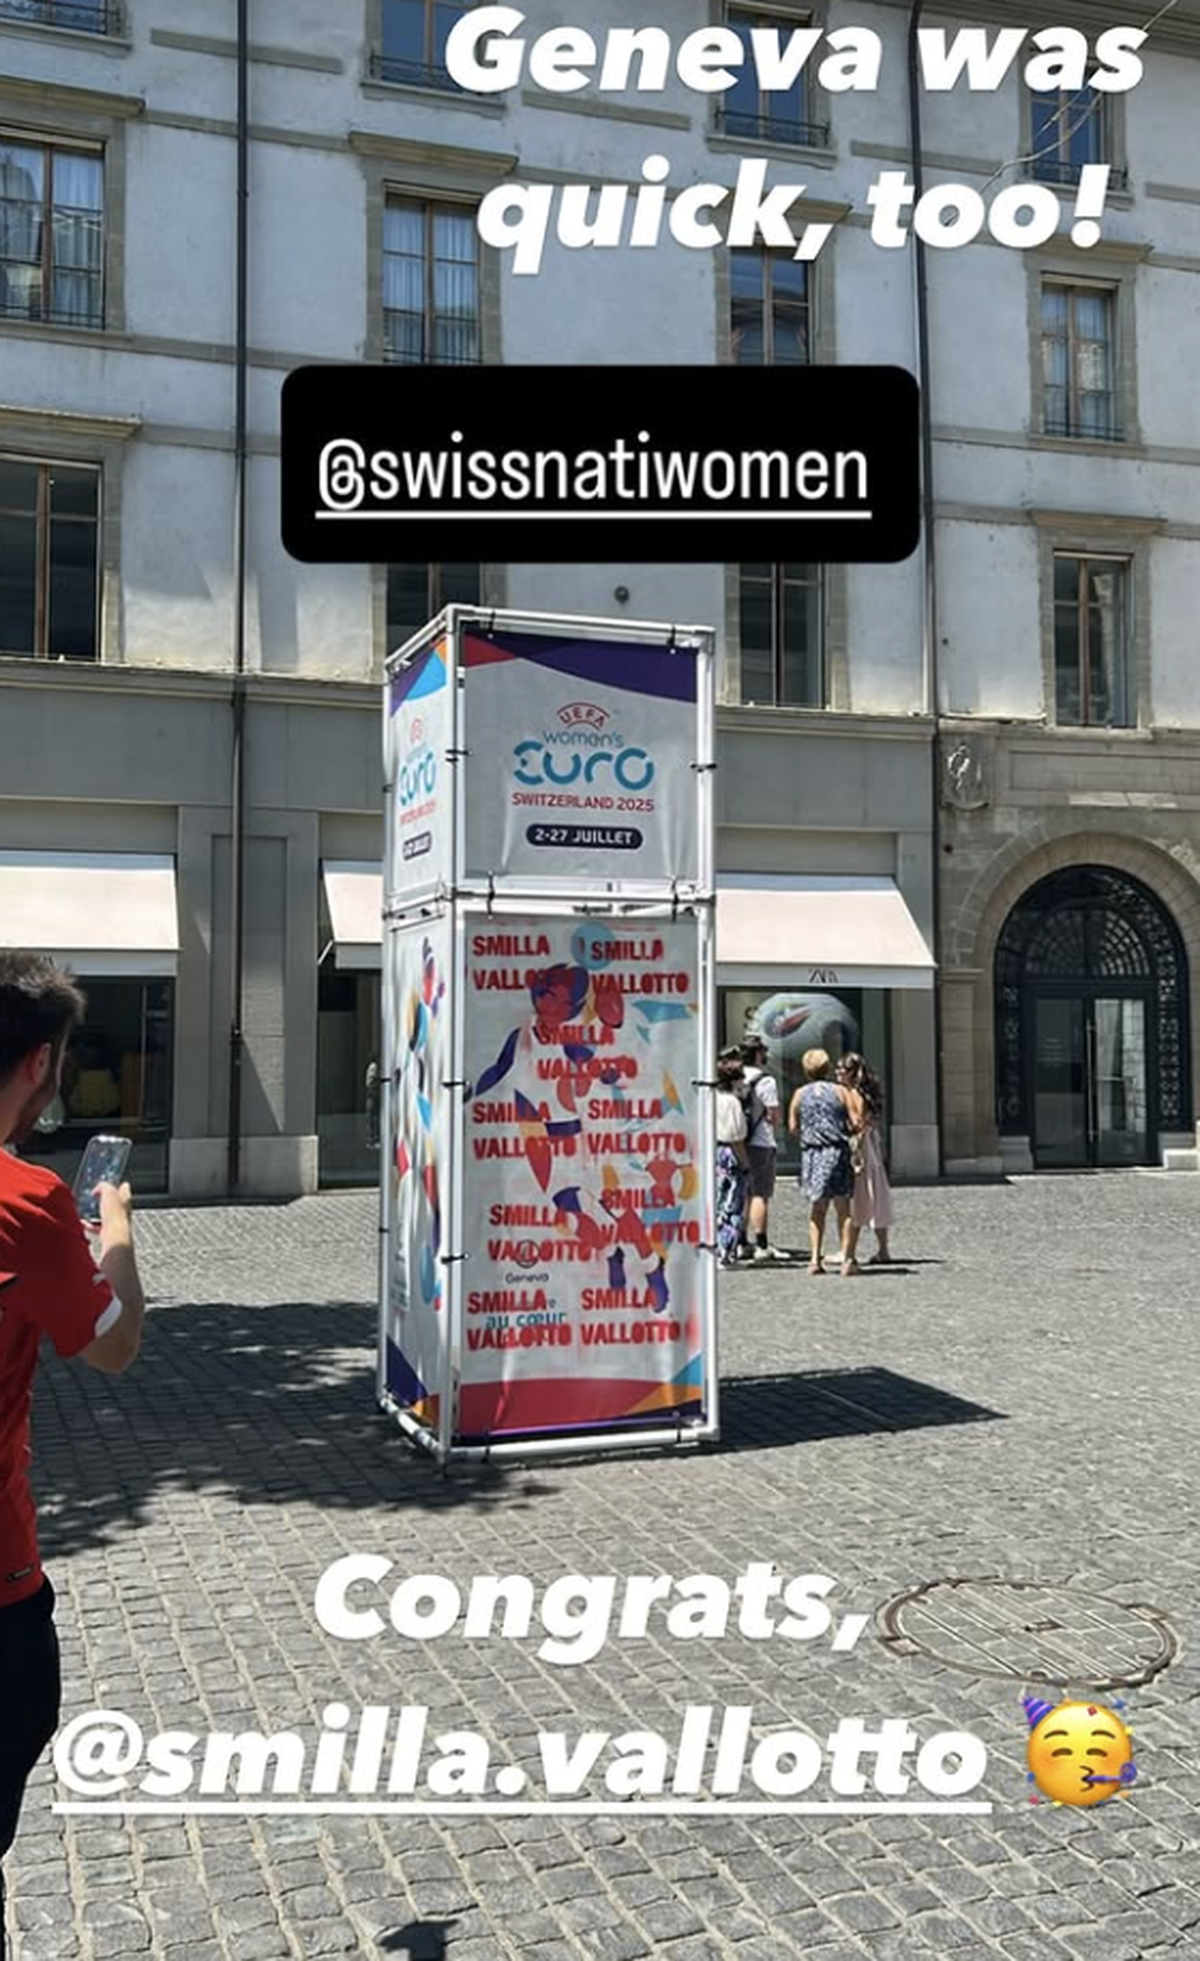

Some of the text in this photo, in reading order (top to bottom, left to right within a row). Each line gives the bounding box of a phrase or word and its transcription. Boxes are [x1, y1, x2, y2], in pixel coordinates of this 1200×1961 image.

[559, 706, 606, 728] UEFA
[543, 731, 624, 748] women's
[512, 792, 655, 812] SWITZERLAND 2025
[572, 829, 633, 845] JUILLET
[472, 936, 550, 956] SMILLA
[591, 938, 664, 961] SMILLA
[472, 968, 575, 990] VALLO
[592, 972, 689, 995] VALLOTTO
[472, 1100, 551, 1124] SMILLA
[588, 1097, 664, 1119] SMILLA
[587, 1132, 686, 1155] VALLOTTO
[489, 1204, 569, 1227] SMILLA
[488, 1238, 591, 1262] VALLOTTO
[467, 1288, 547, 1314] SMILLA
[581, 1287, 657, 1310] SMILLA
[485, 1316, 509, 1330] au
[580, 1321, 681, 1345] VALLOTTO
[466, 1323, 572, 1351] VALLOTTO
